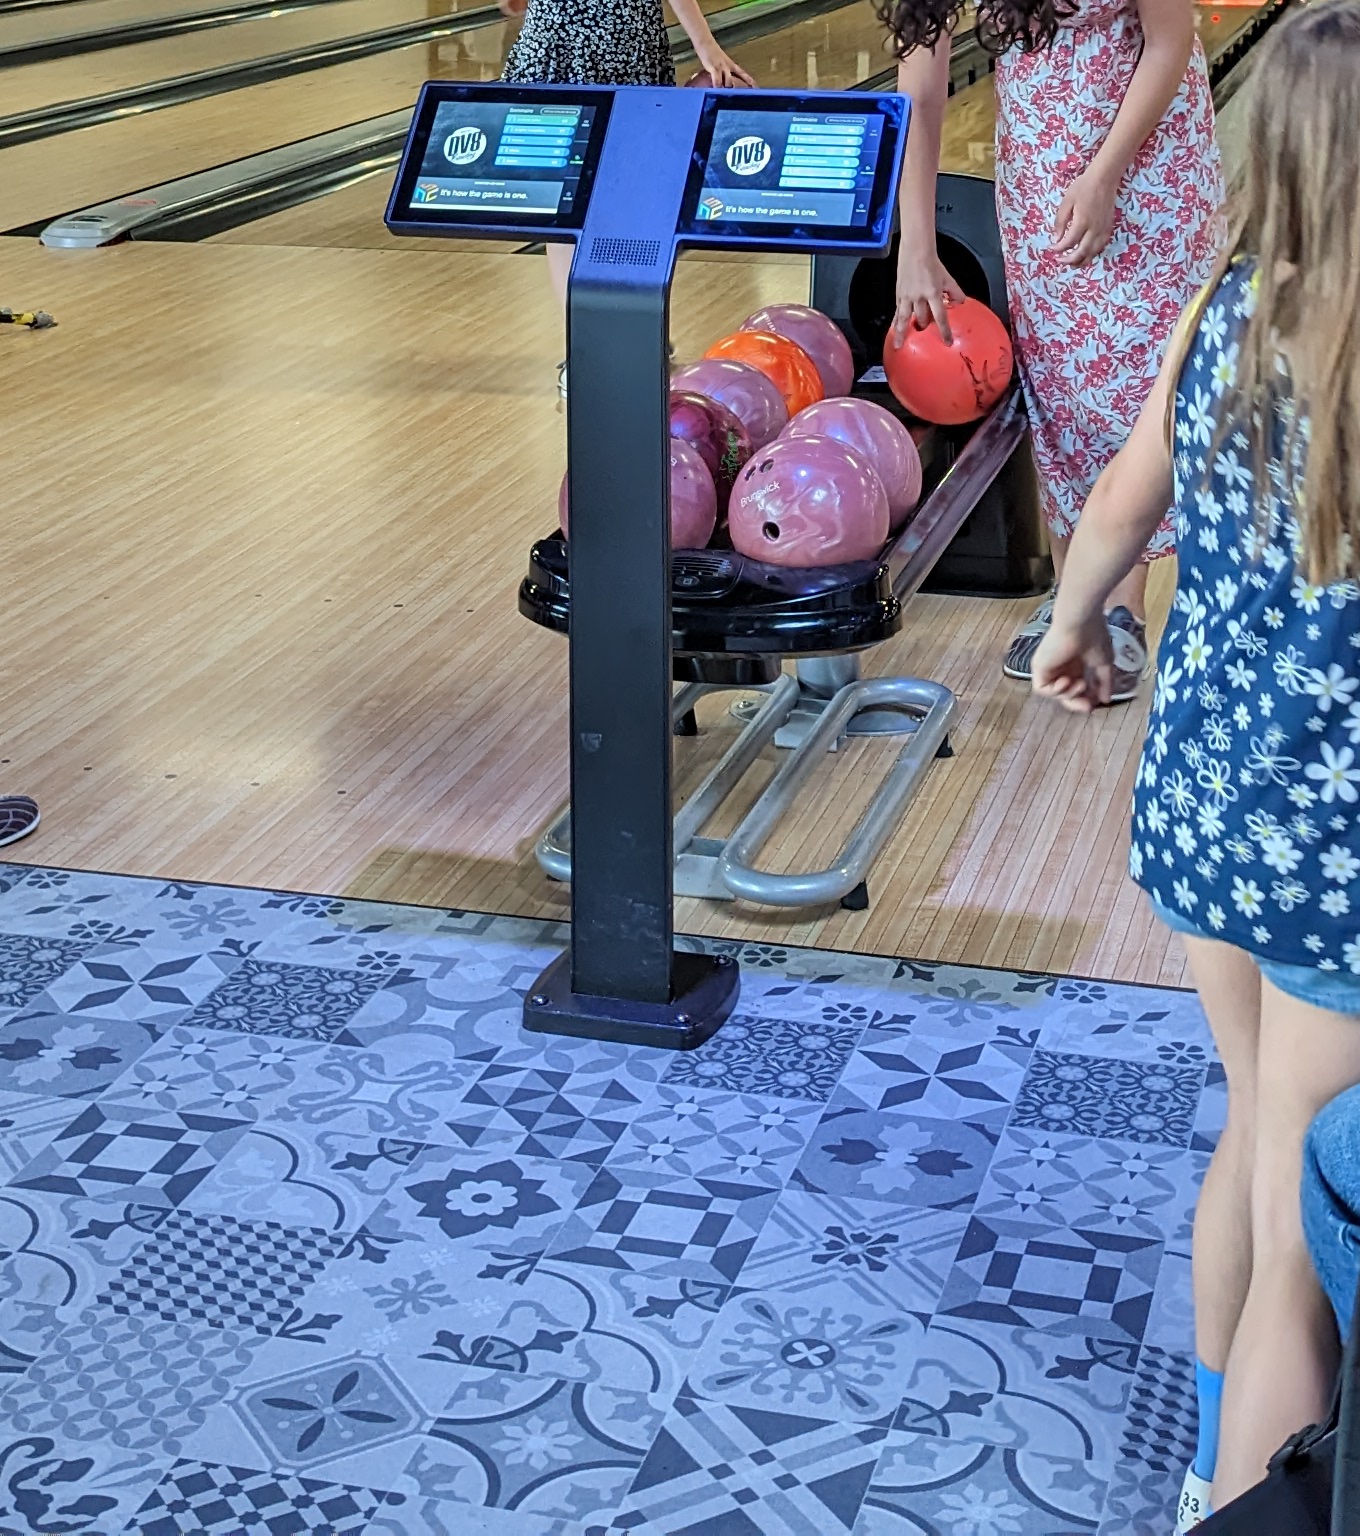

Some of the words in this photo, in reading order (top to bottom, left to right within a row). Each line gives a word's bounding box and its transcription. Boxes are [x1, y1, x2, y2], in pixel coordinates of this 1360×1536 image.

[448, 132, 483, 156] DV8
[731, 141, 766, 167] DV8
[738, 206, 754, 214] how
[740, 481, 780, 508] Brunswick
